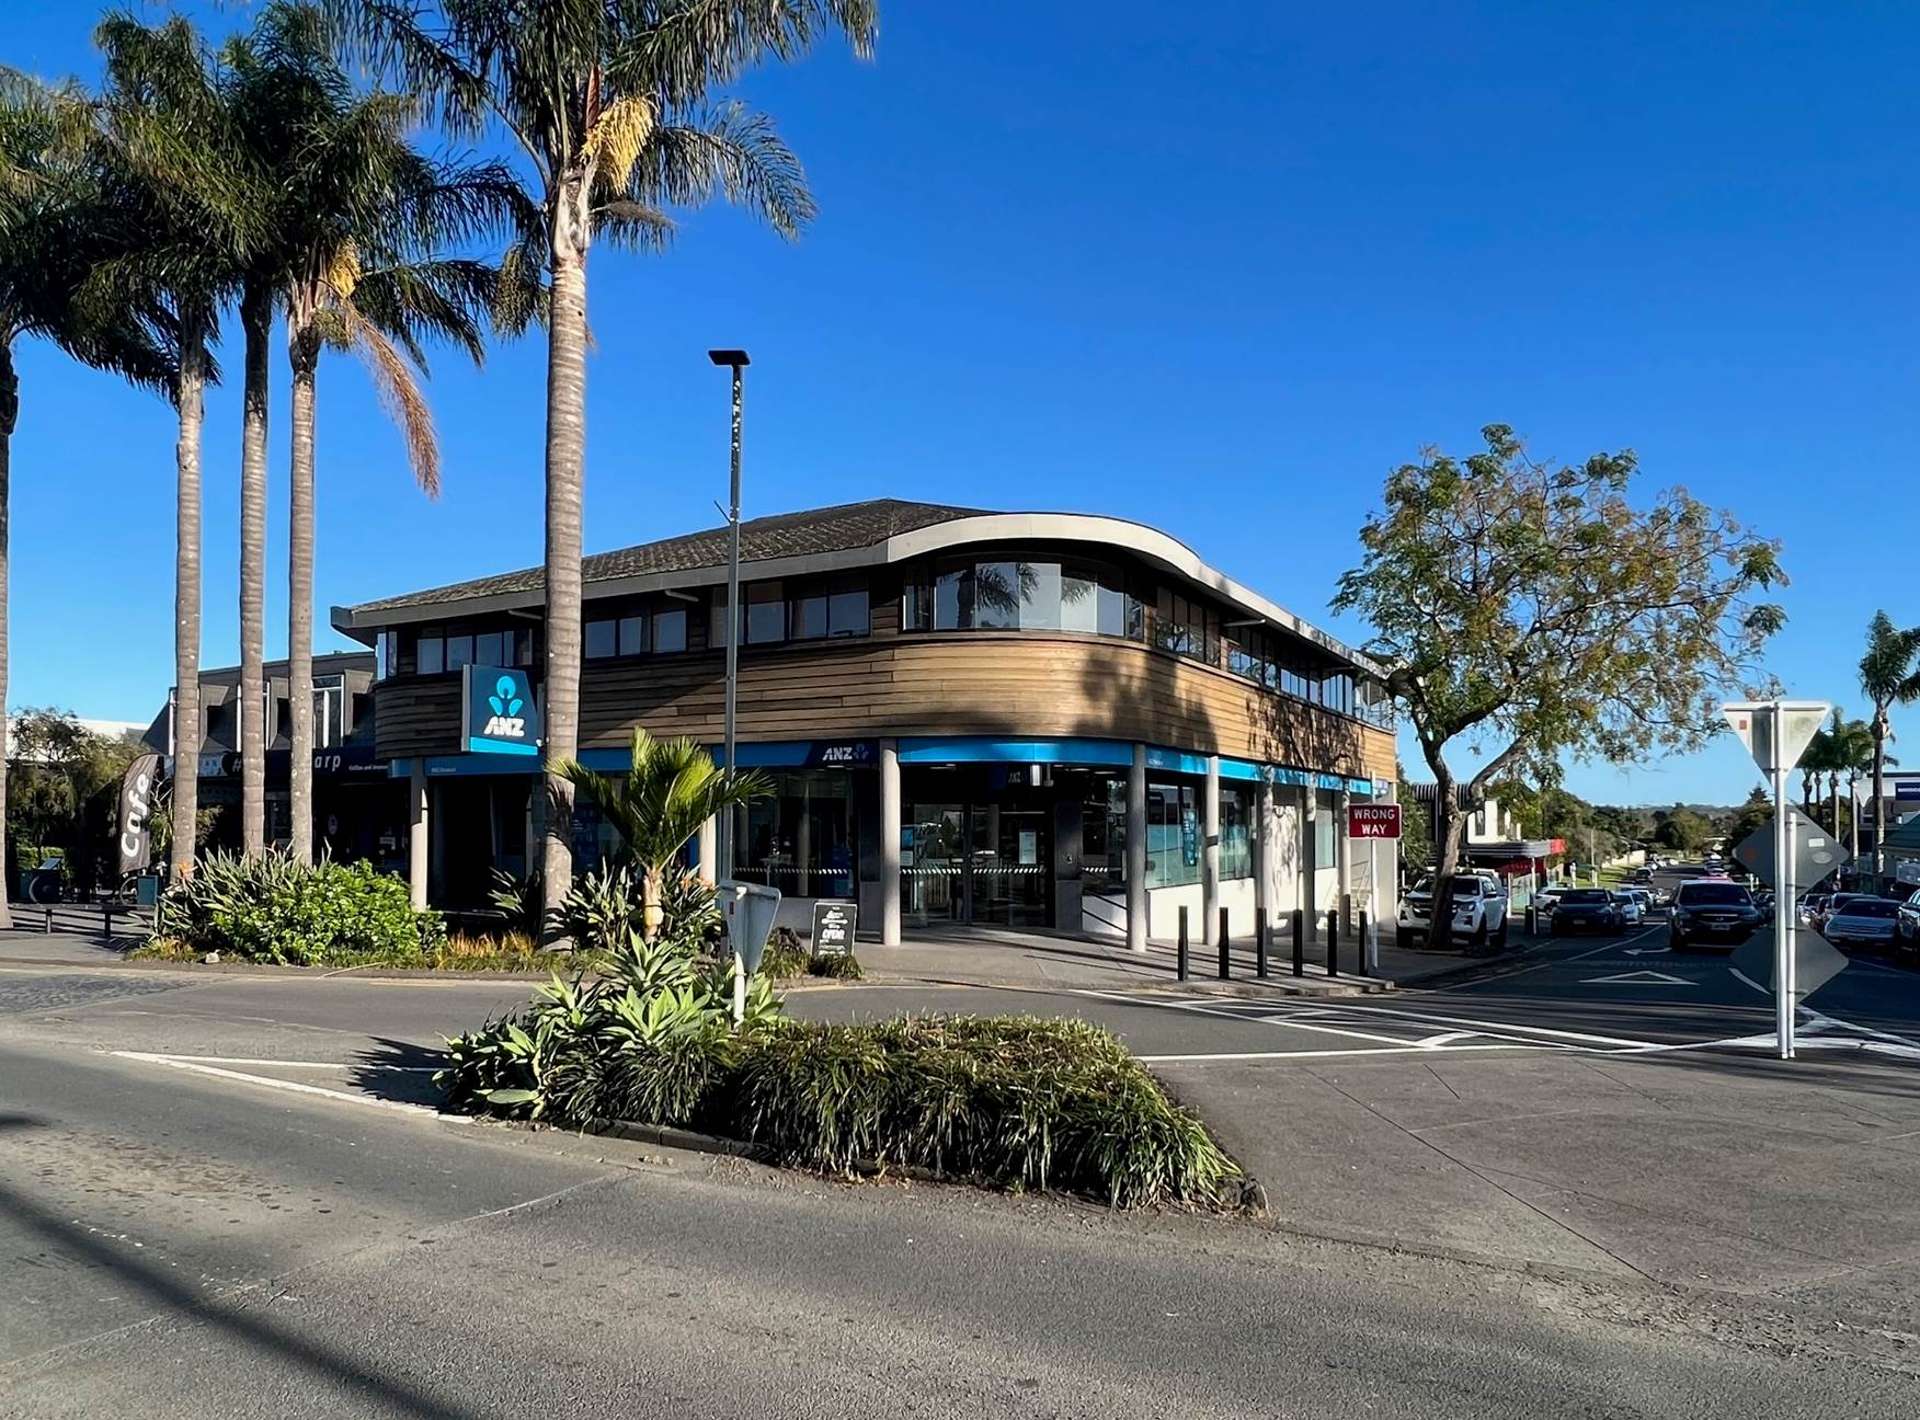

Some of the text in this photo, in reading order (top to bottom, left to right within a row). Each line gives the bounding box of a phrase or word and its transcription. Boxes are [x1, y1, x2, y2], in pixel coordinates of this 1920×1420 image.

[483, 716, 525, 736] ANZ
[822, 746, 853, 760] ANZ
[121, 773, 149, 858] Cafe
[1353, 809, 1396, 820] WRONG
[1361, 824, 1387, 835] WAY
